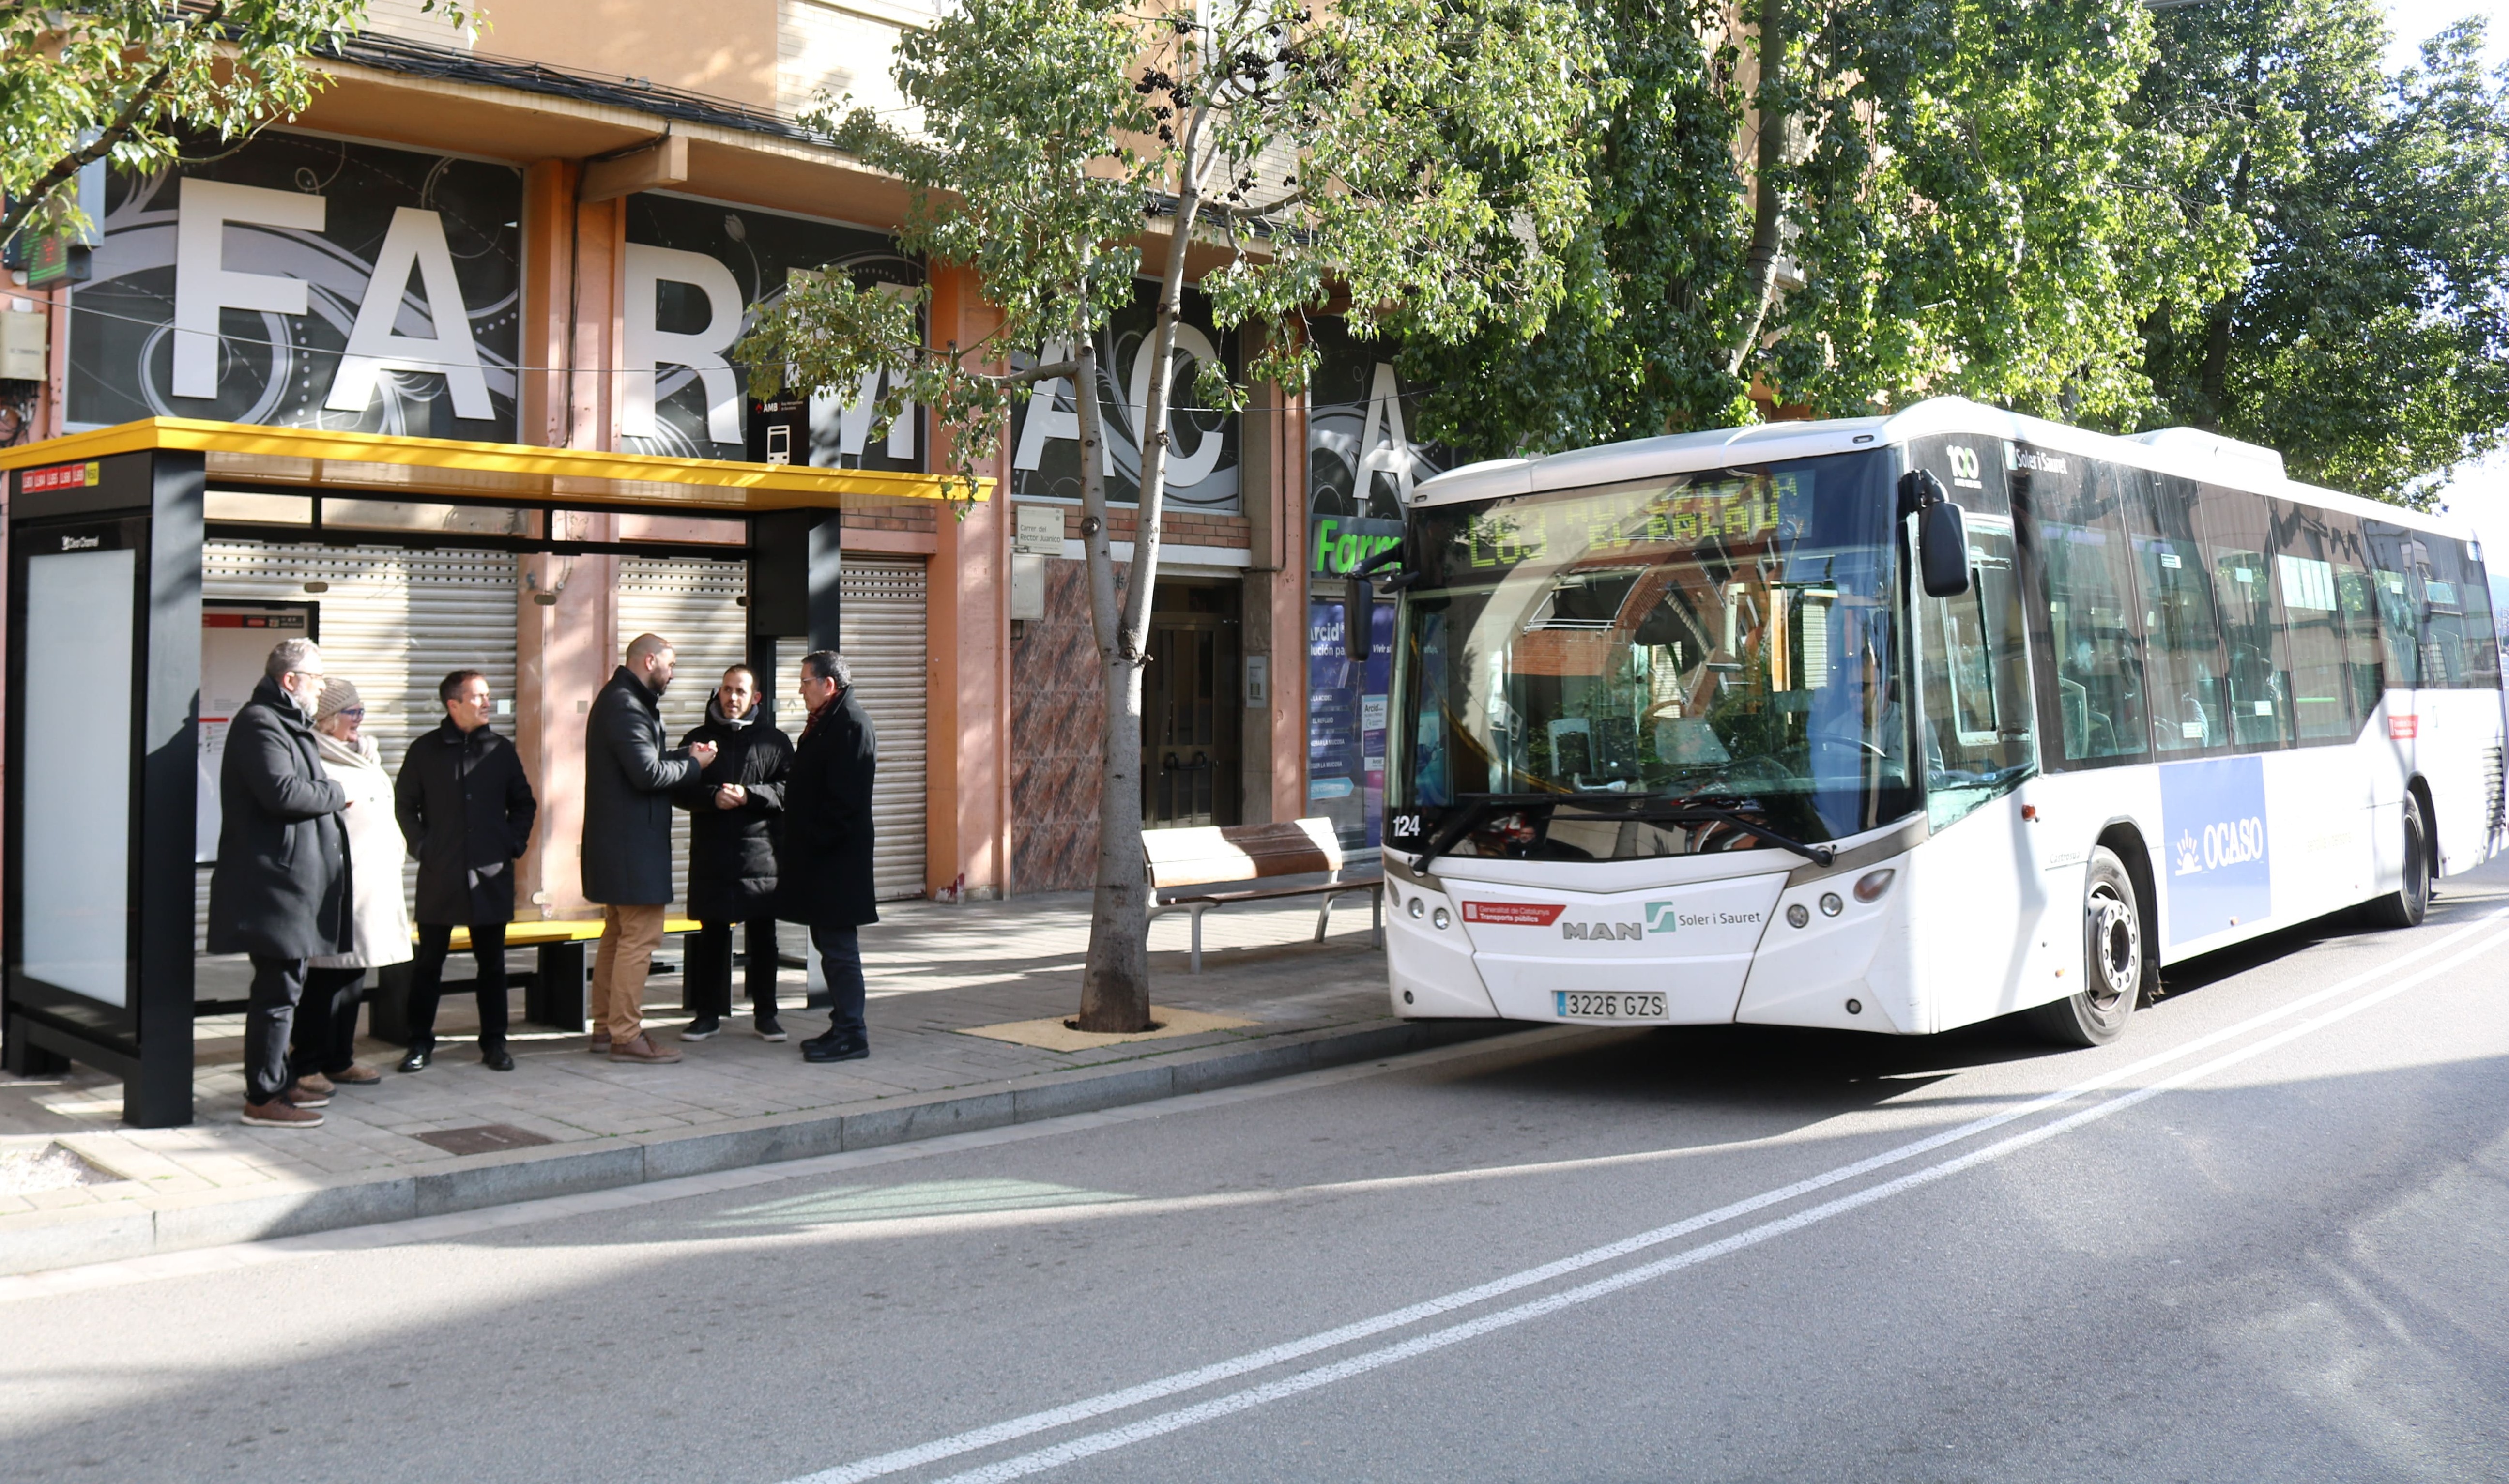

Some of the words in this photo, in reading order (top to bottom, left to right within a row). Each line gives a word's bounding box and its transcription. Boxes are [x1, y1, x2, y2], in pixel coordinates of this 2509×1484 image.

[763, 402, 778, 413] AMB
[2016, 448, 2037, 471] Soler
[2041, 452, 2068, 475] Sauret
[1588, 522, 1631, 551] EL
[1647, 502, 1779, 543] PALAU
[1020, 533, 1038, 541] Rector
[1469, 508, 1547, 568] L63
[1373, 644, 1386, 653] Vivir
[1393, 815, 1421, 837] 124
[2203, 816, 2263, 870] OCASO
[1479, 905, 1509, 914] Generalitat
[1519, 907, 1550, 916] Catalunya
[1480, 913, 1514, 922] Transports
[1679, 914, 1710, 926] Soler
[1713, 913, 1717, 924] i
[1719, 912, 1761, 924] Sauret
[1562, 922, 1642, 940] MAN
[1569, 994, 1617, 1015] 3226
[1624, 996, 1663, 1016] GZS
